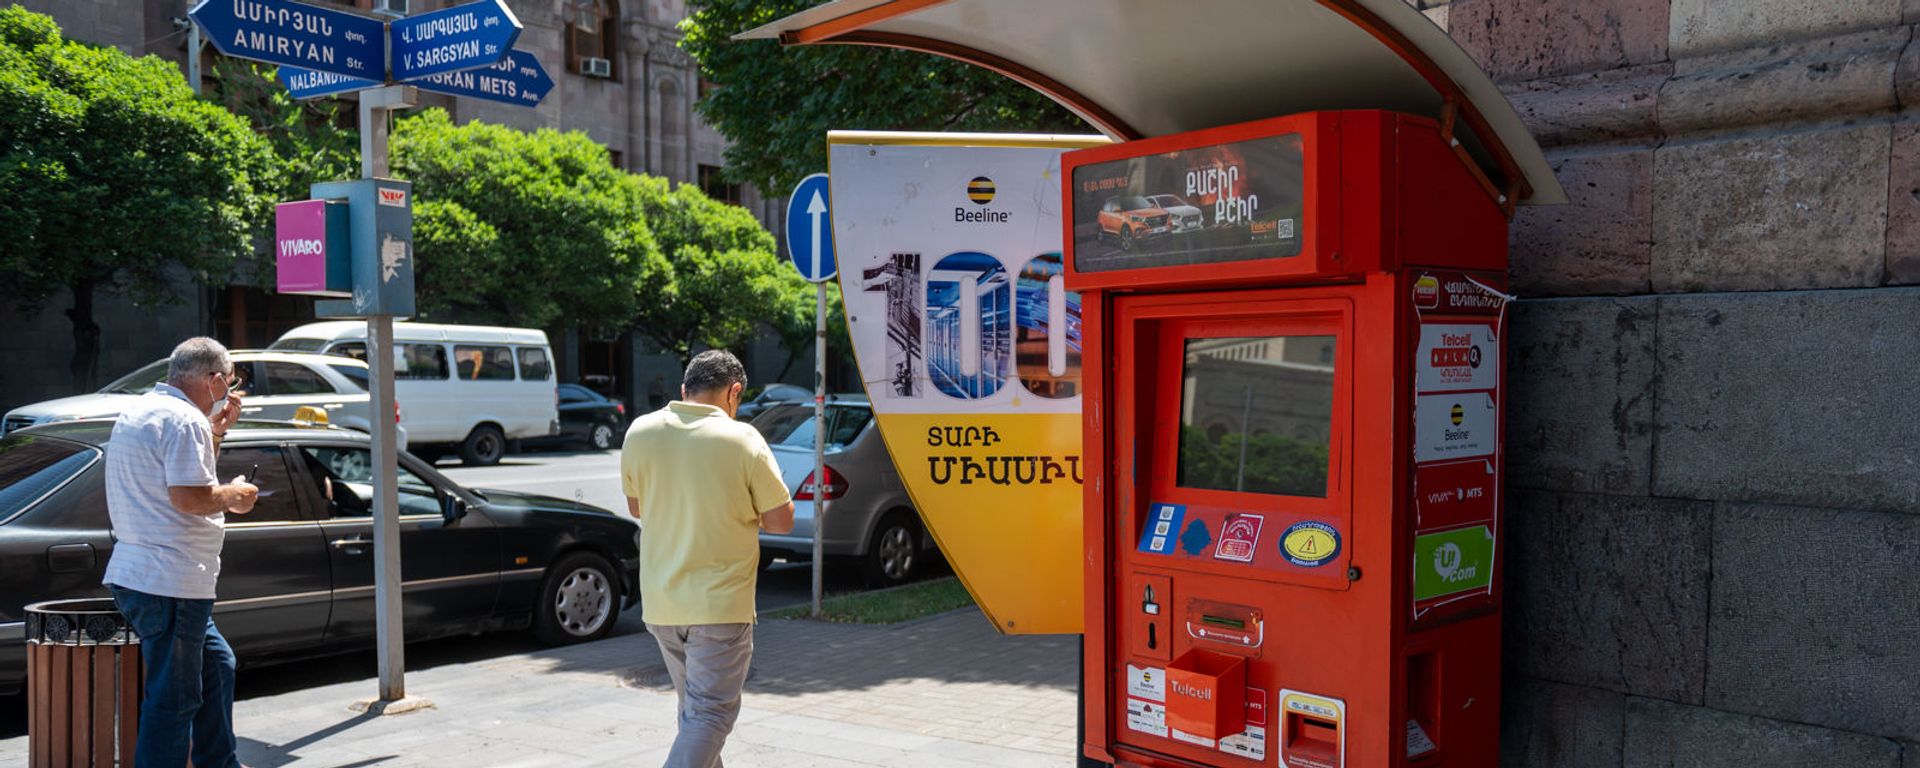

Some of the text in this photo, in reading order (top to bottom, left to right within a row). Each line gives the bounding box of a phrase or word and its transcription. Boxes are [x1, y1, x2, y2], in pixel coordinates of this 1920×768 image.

[233, 0, 333, 36] ԱՄԻՐՅԱՆ
[416, 12, 478, 42] ՍԱՐԳՍՅԱՆ
[234, 29, 365, 70] AMIRYAN Str.
[404, 39, 498, 71] V. SARGSYAN Str.
[479, 75, 517, 97] METS
[955, 207, 1008, 223] Beeline
[280, 238, 323, 257] VIVARO
[862, 250, 1082, 400] 100
[1441, 333, 1472, 347] Telcell
[928, 426, 1001, 447] ՏԱՐԻ
[1444, 428, 1469, 441] Beeline
[1466, 487, 1483, 498] MTS
[1171, 680, 1211, 700] Telcell
